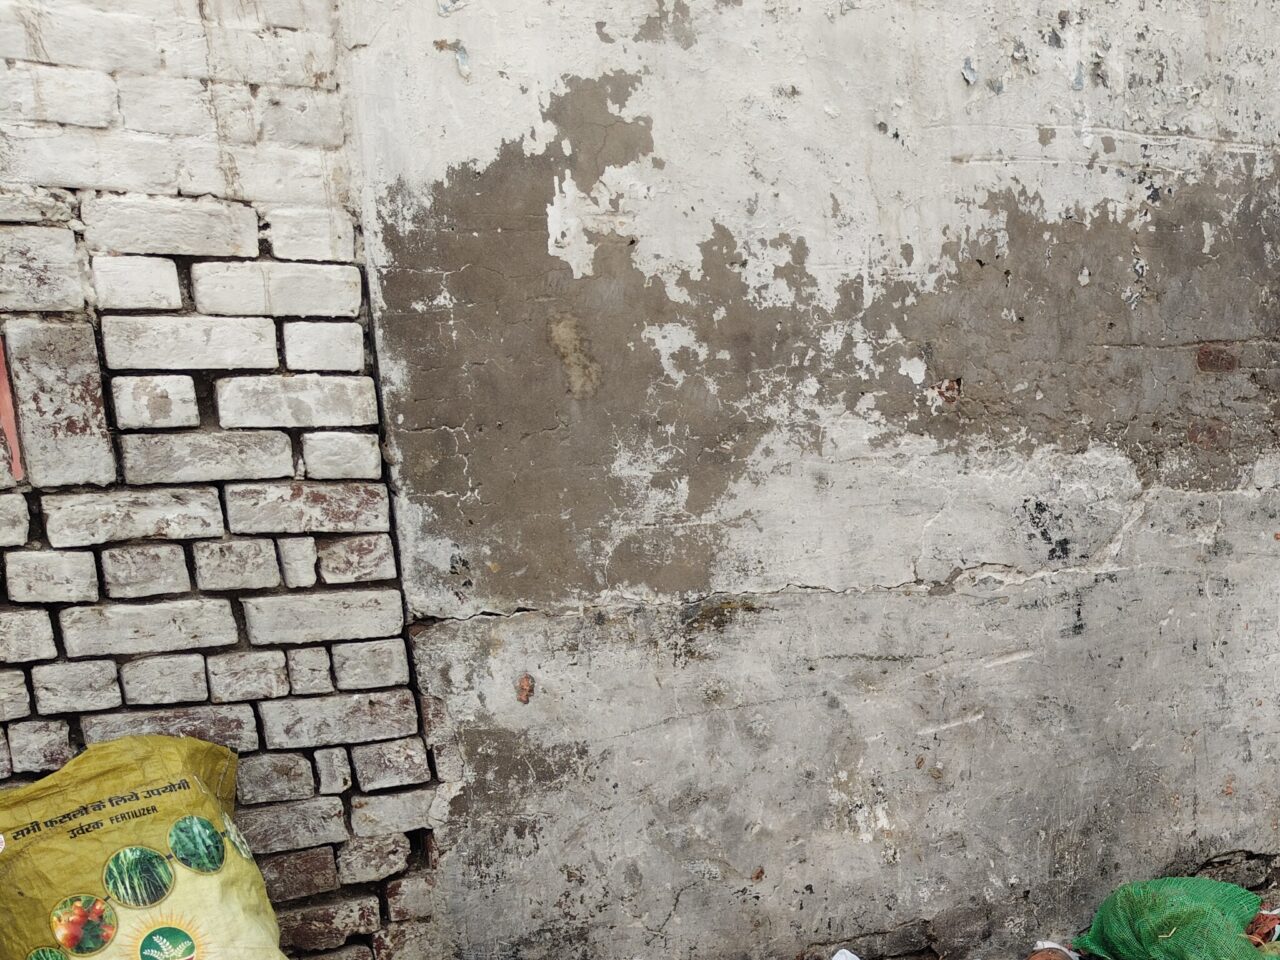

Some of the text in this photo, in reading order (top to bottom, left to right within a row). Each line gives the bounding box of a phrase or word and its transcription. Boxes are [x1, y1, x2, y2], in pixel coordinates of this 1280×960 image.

[12, 821, 42, 841] सभी
[109, 792, 140, 808] लिये
[142, 778, 191, 799] उपयोगी
[67, 805, 159, 840] उर्वरक FERTILIZER
